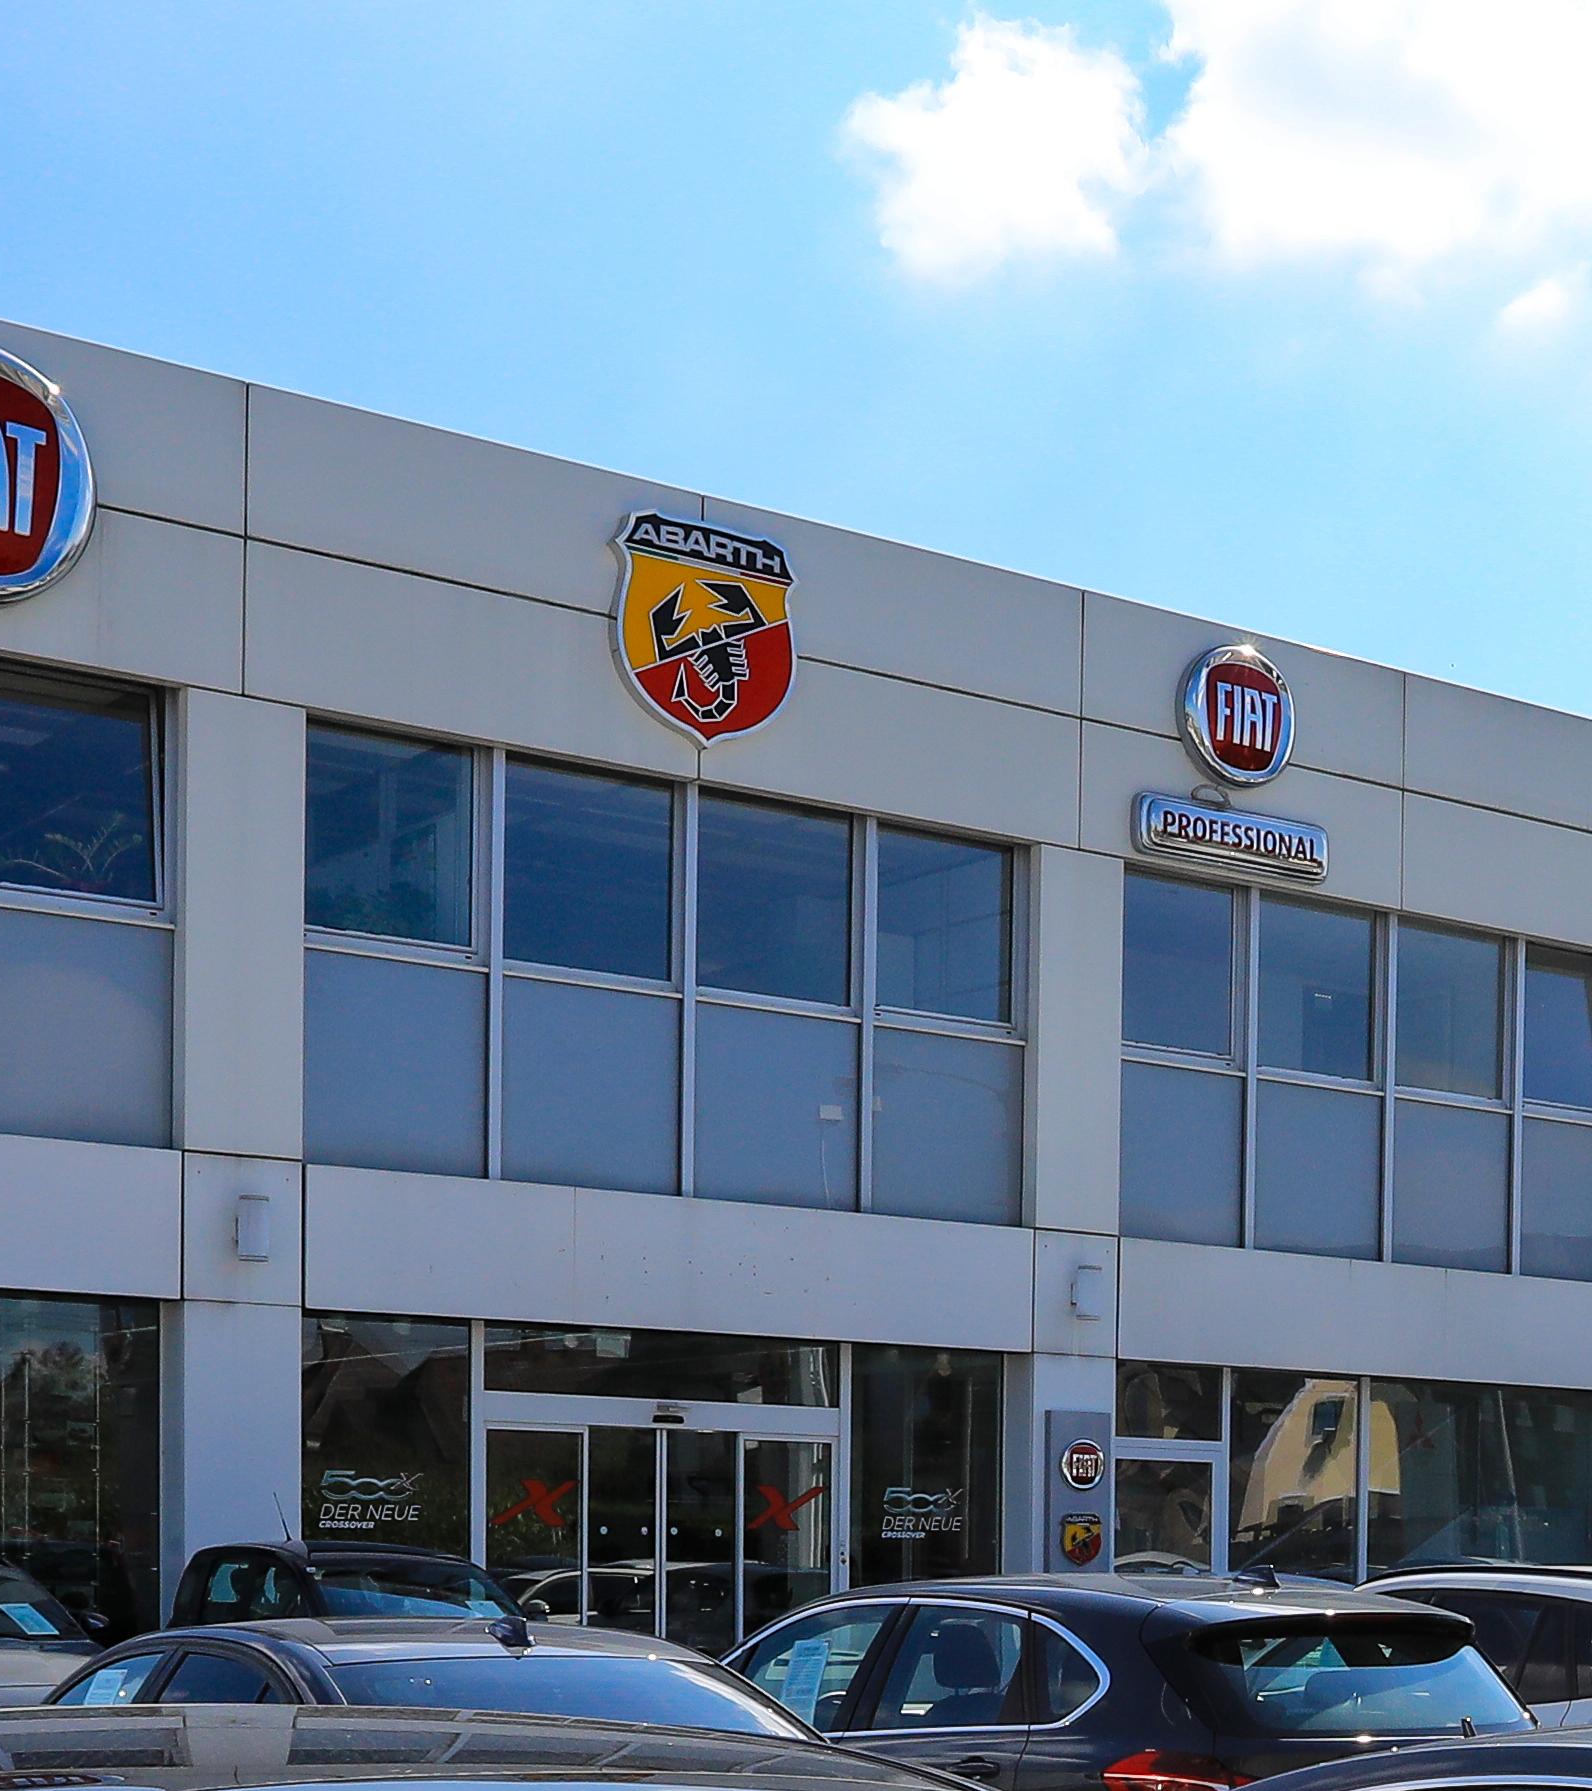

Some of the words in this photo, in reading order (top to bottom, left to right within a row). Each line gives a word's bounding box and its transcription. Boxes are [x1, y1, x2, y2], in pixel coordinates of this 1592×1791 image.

[631, 518, 782, 574] ABARTH
[1215, 680, 1279, 752] FIAT
[1162, 809, 1320, 864] PROFESSIONAL
[1072, 1453, 1097, 1477] FIAT
[319, 1503, 362, 1519] DER
[366, 1504, 422, 1521] NEUE
[881, 1516, 916, 1530] DER
[919, 1517, 963, 1531] NEUE
[318, 1520, 375, 1529] CROSSOVER
